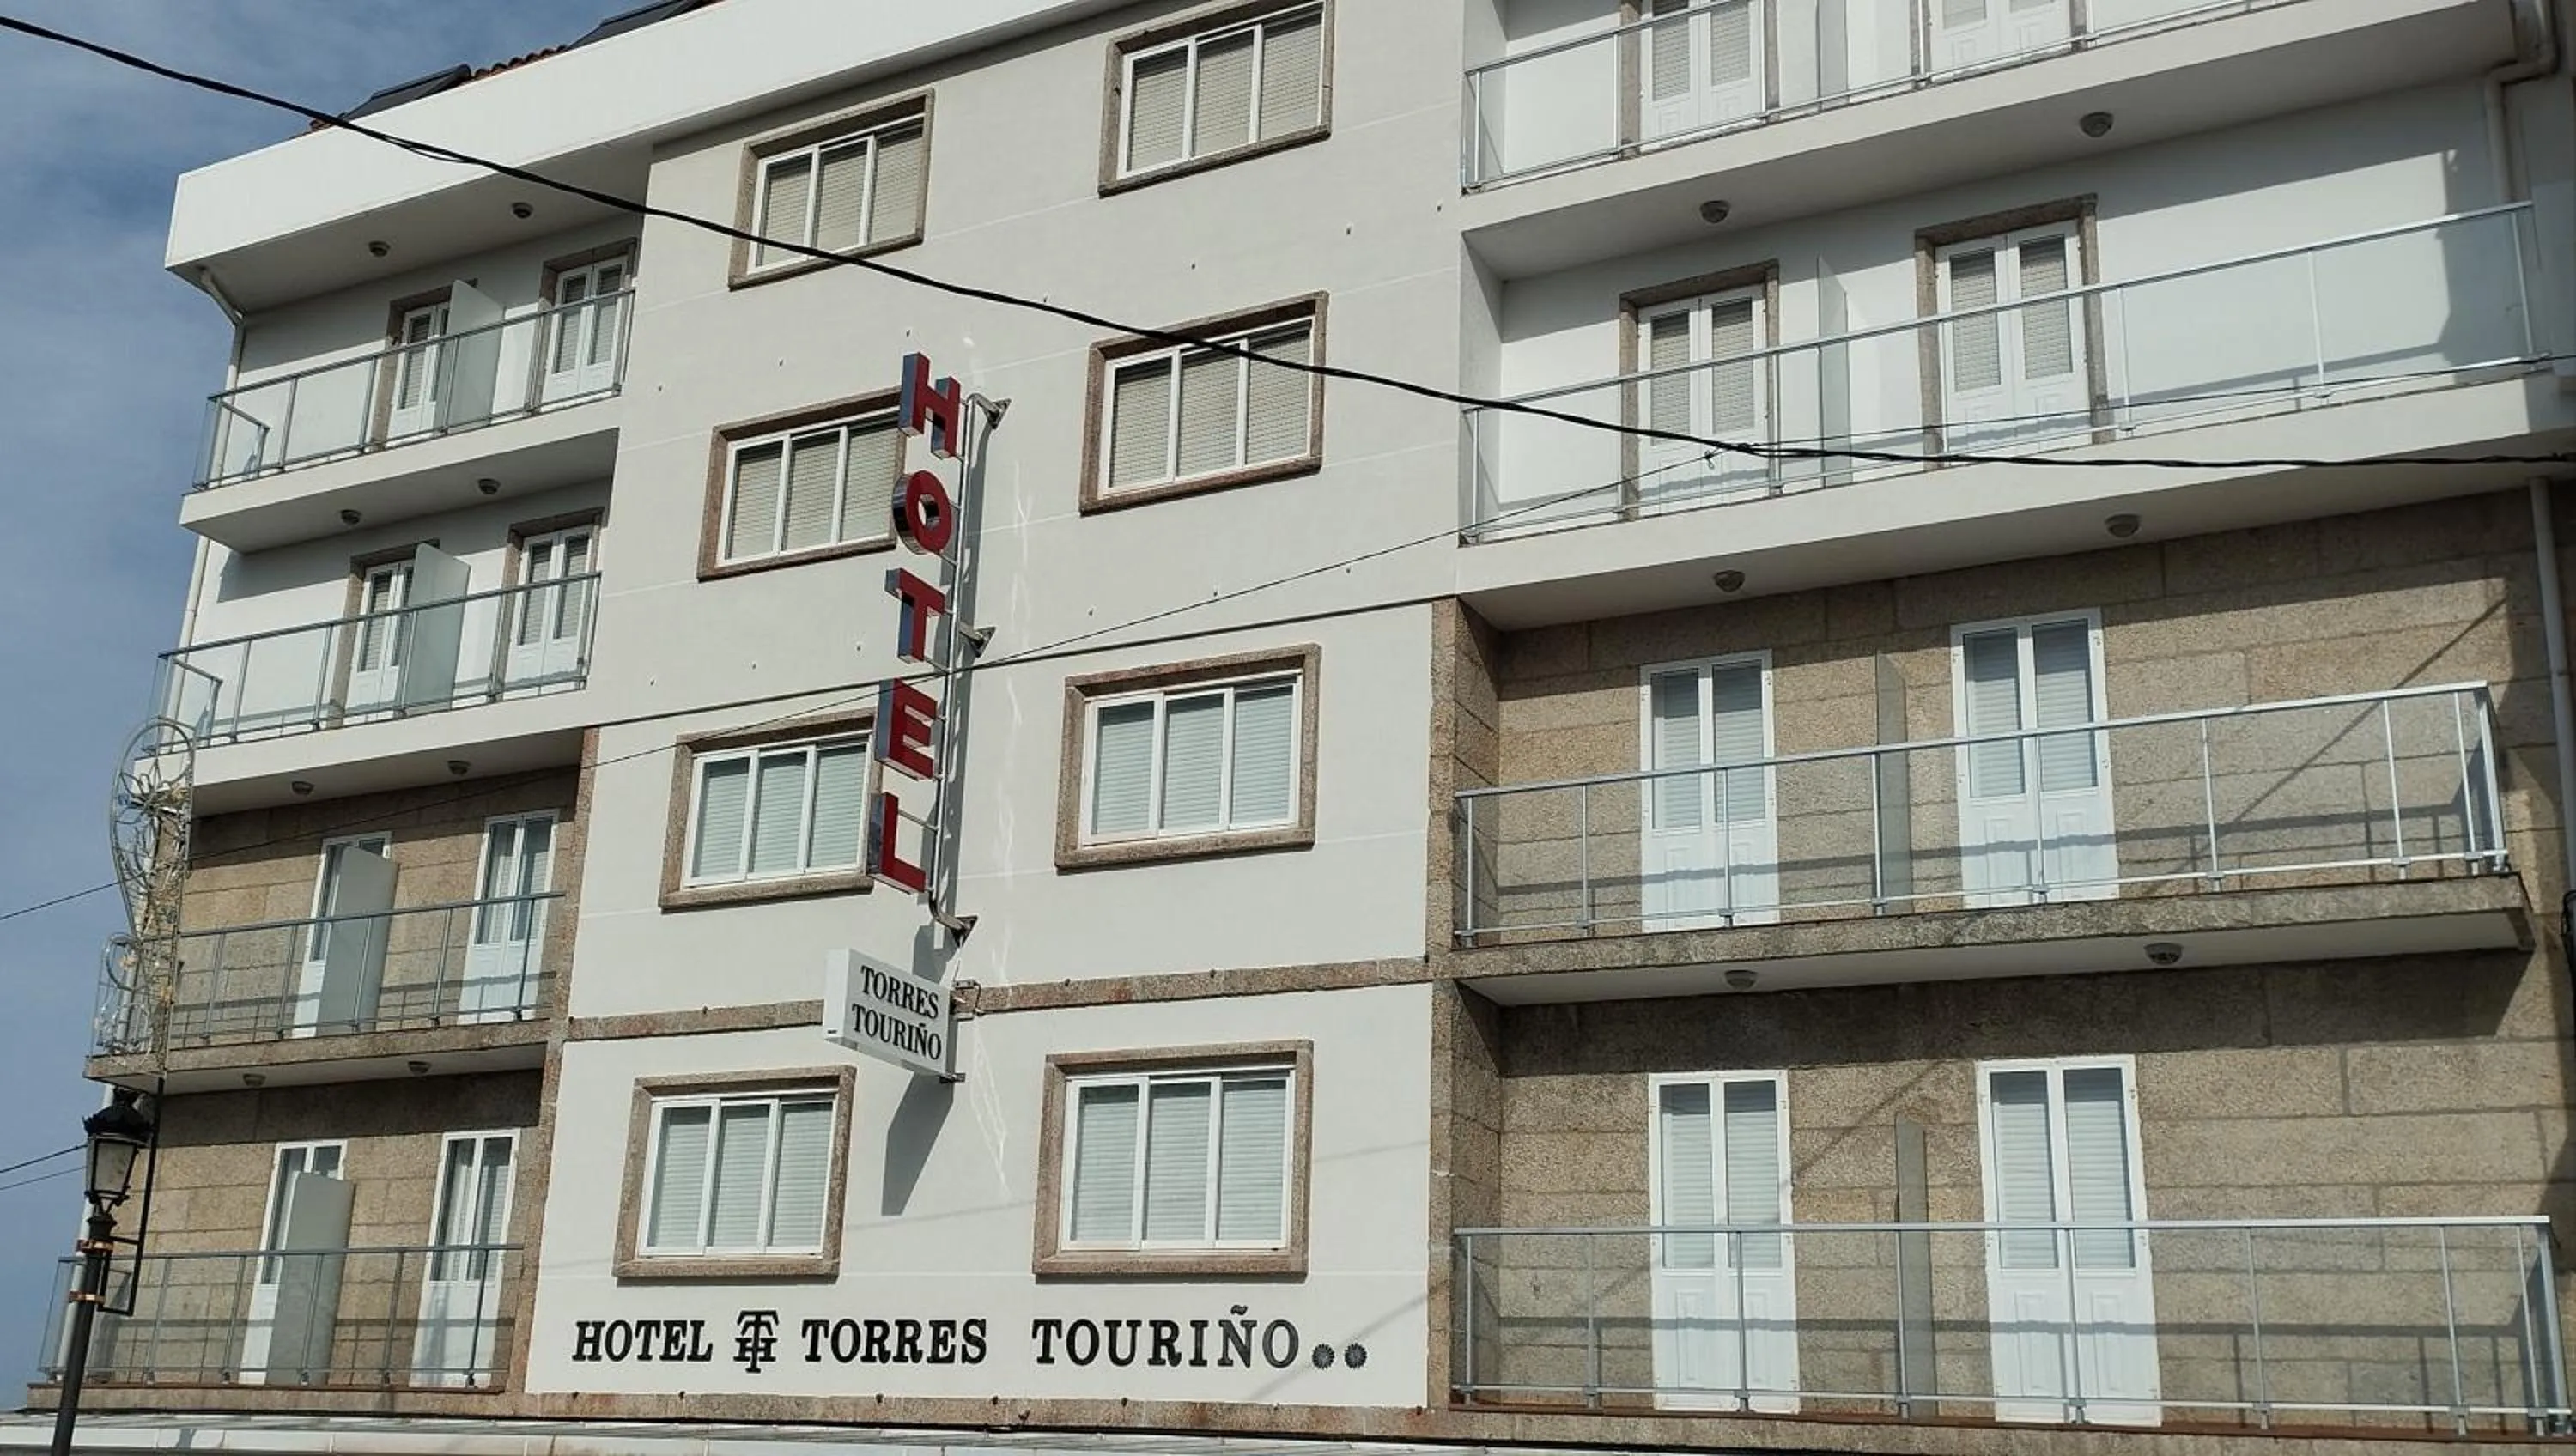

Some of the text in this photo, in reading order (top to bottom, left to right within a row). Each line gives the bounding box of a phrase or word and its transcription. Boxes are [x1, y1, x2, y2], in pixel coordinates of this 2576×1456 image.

[869, 353, 961, 894] HOTEL
[861, 965, 939, 1019] TORRES
[852, 1004, 941, 1060] TOURIÑO
[572, 1320, 714, 1362] HOTEL
[801, 1318, 987, 1365] TORRES
[1031, 1304, 1299, 1371] TOURIÑO
